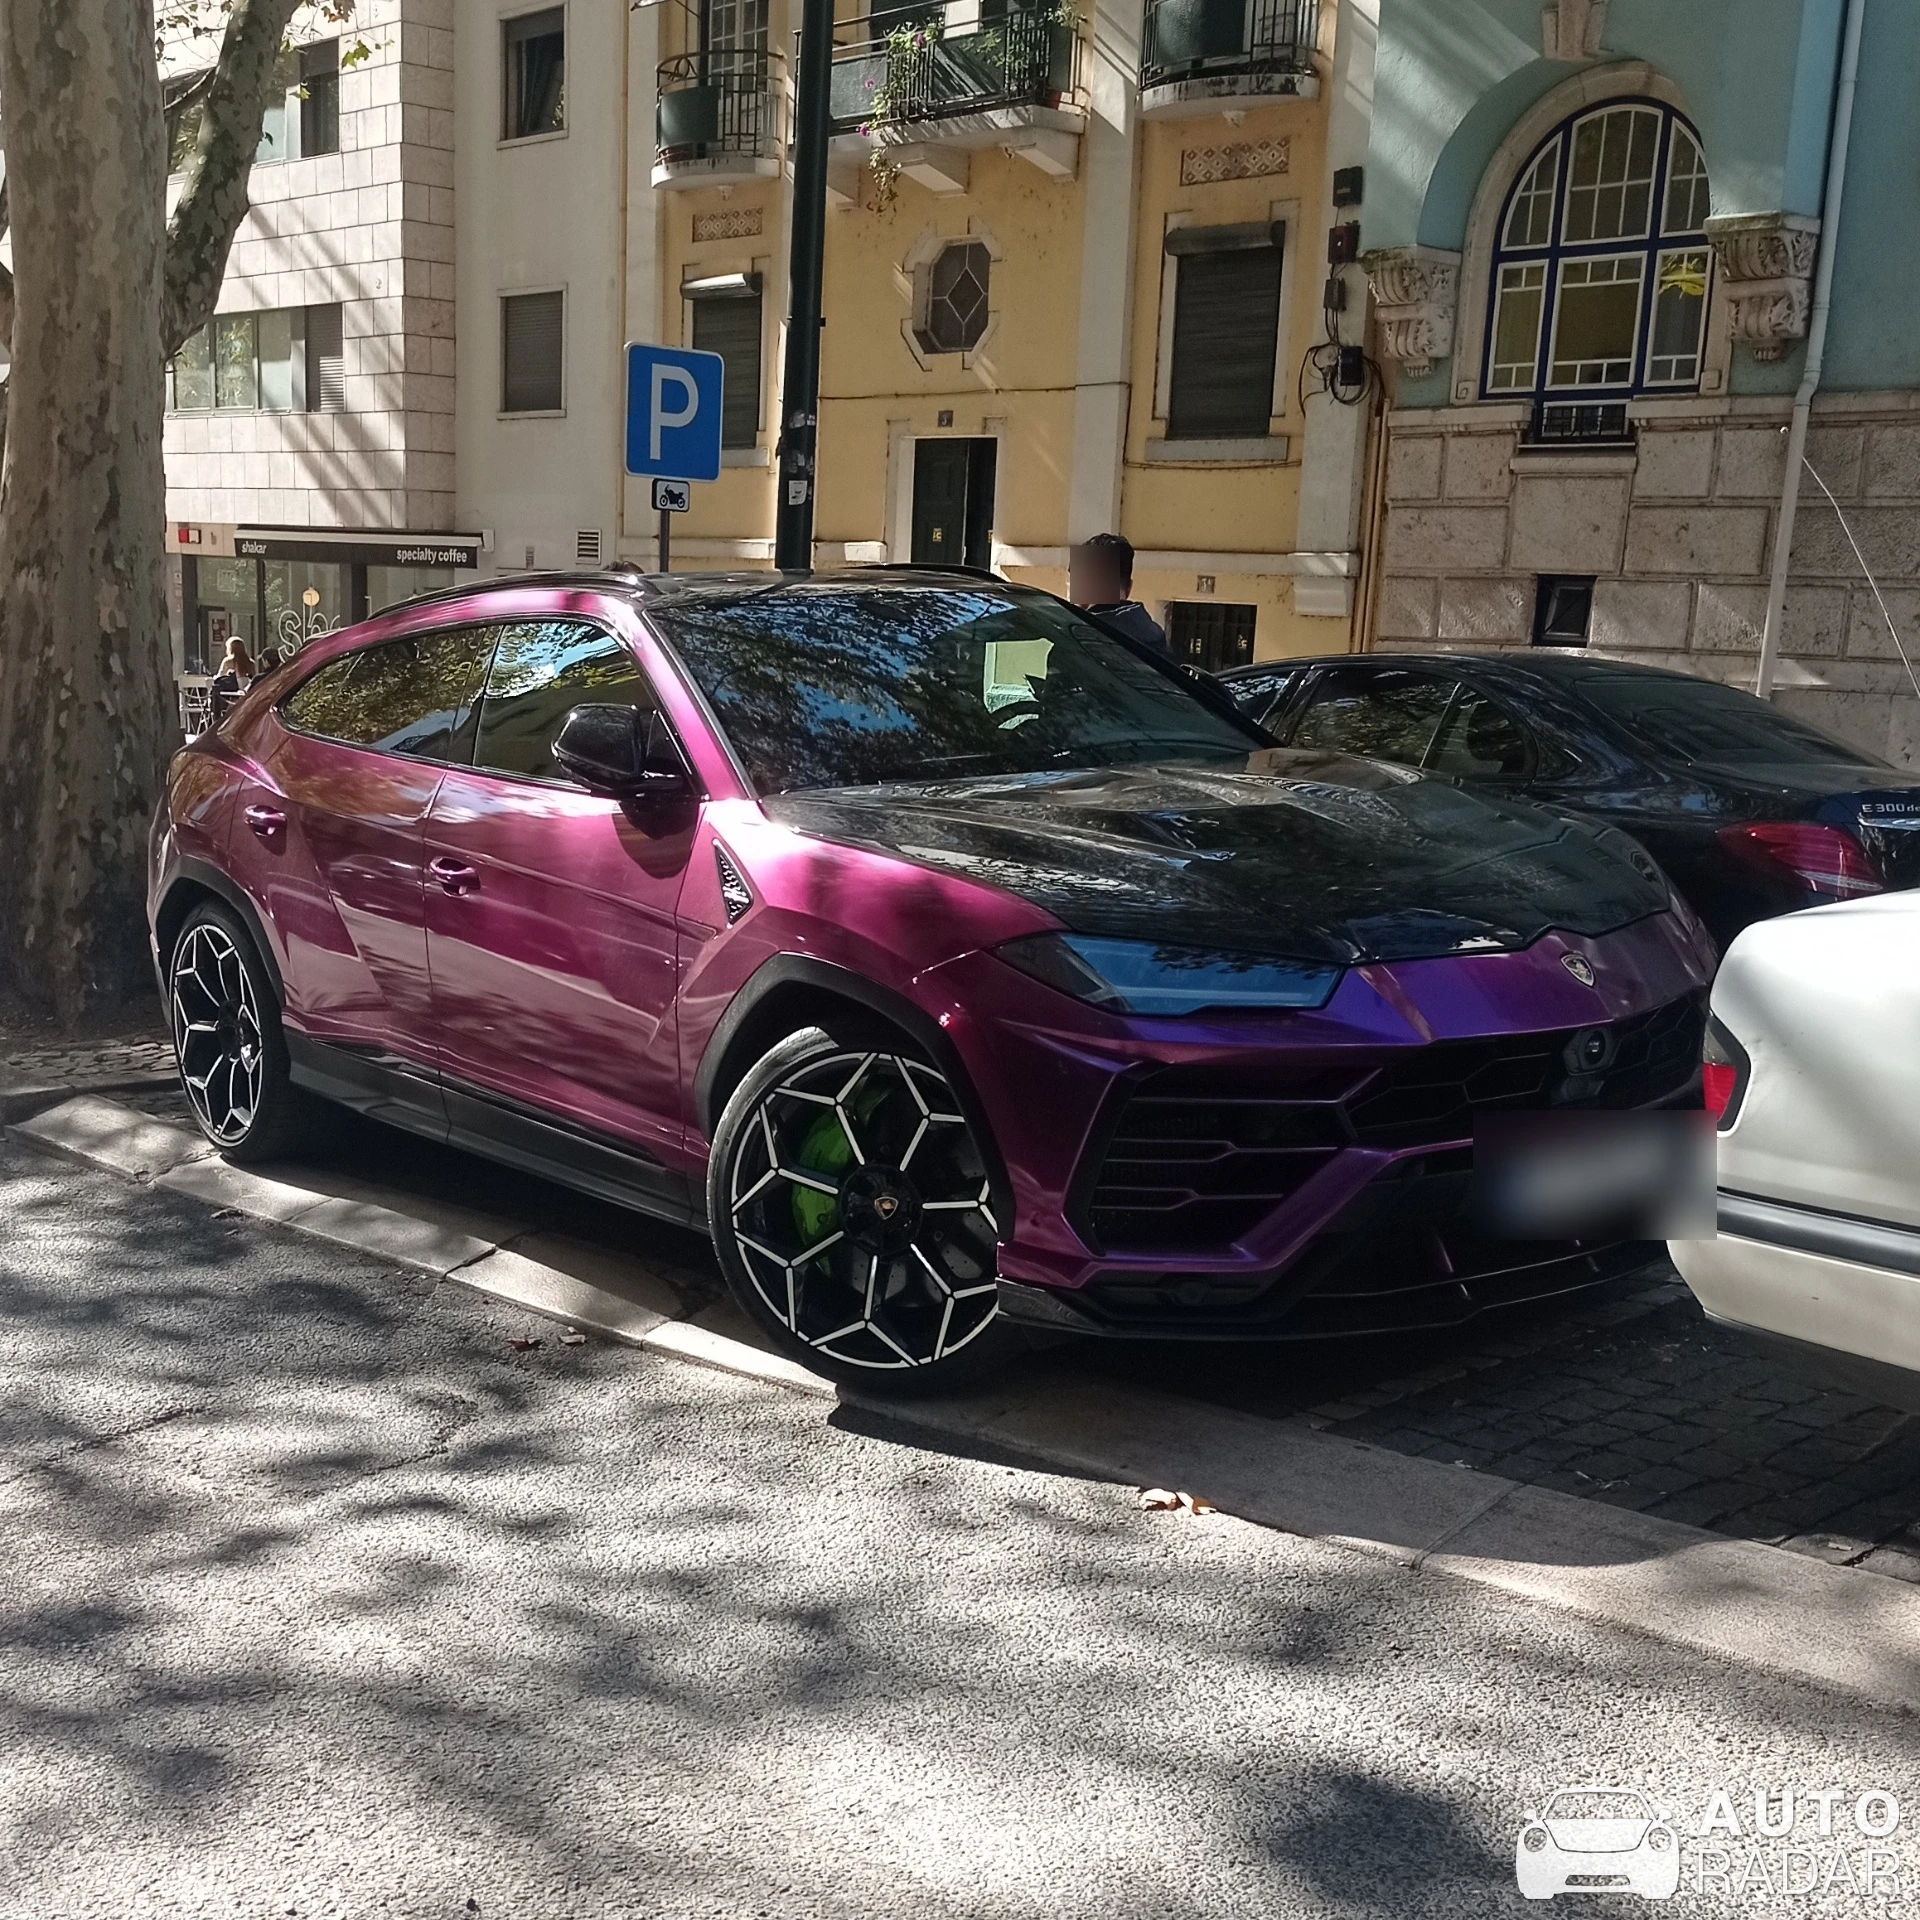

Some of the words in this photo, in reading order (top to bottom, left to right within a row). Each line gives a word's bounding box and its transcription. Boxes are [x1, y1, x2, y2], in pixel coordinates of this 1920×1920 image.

[650, 363, 699, 460] P
[396, 547, 437, 565] specialty
[438, 548, 468, 563] coffee
[1862, 804, 1873, 813] E
[1875, 803, 1905, 813] 300
